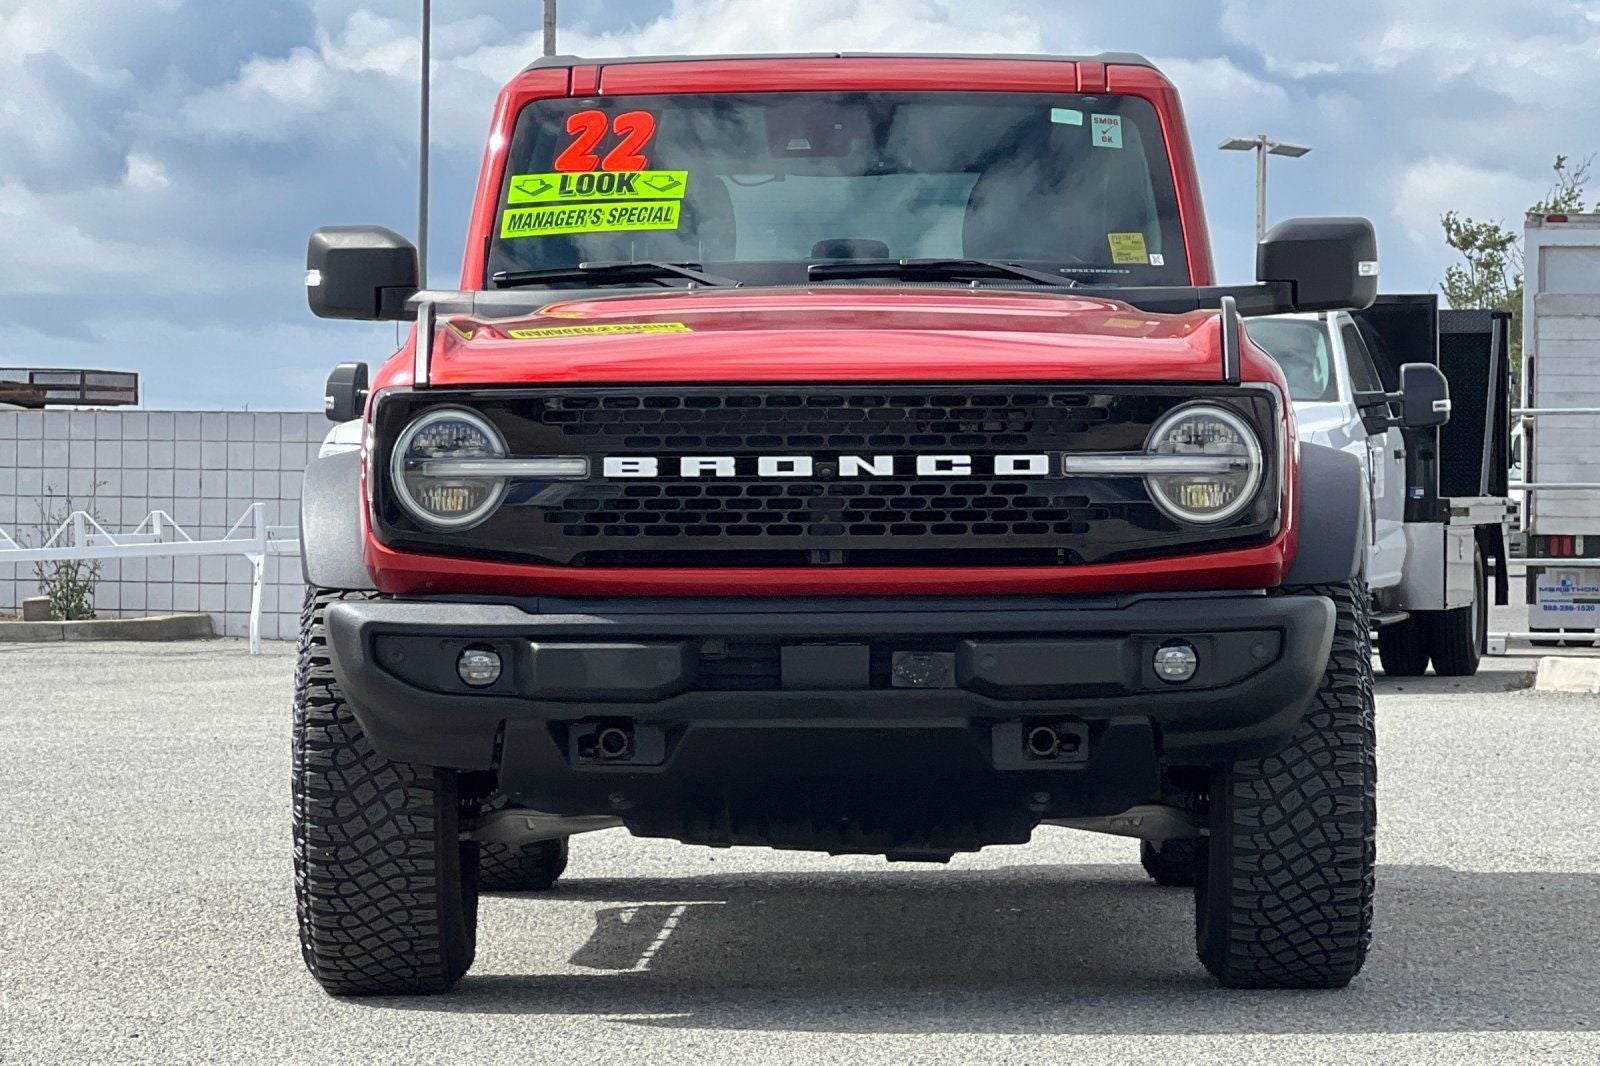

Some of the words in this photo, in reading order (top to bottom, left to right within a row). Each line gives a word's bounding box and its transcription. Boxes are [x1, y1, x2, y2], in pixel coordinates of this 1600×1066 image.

[1093, 117, 1119, 126] SMOG
[554, 110, 656, 171] 22
[559, 173, 641, 197] LOOK
[507, 208, 603, 231] MANAGER'S
[606, 206, 674, 226] SPECIAL
[603, 455, 1049, 477] BRONCO
